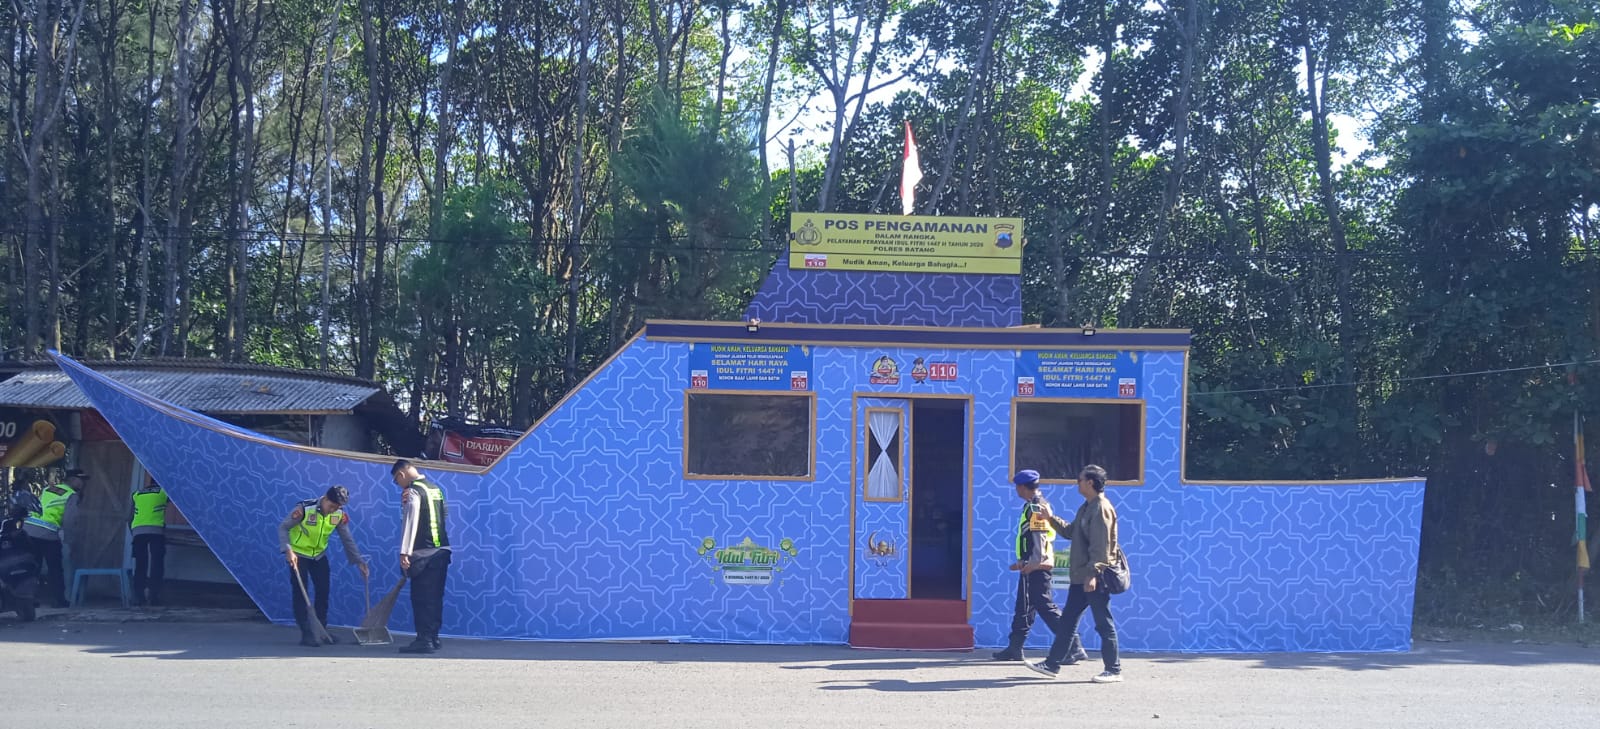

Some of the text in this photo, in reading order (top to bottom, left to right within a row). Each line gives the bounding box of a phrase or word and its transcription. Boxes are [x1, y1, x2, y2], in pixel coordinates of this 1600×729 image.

[824, 219, 859, 230] POS
[864, 220, 988, 233] PENGAMANAN
[842, 258, 865, 266] Mudik
[892, 260, 926, 269] Keluarga
[930, 366, 956, 377] 110
[717, 550, 778, 565] Idul Fitri
